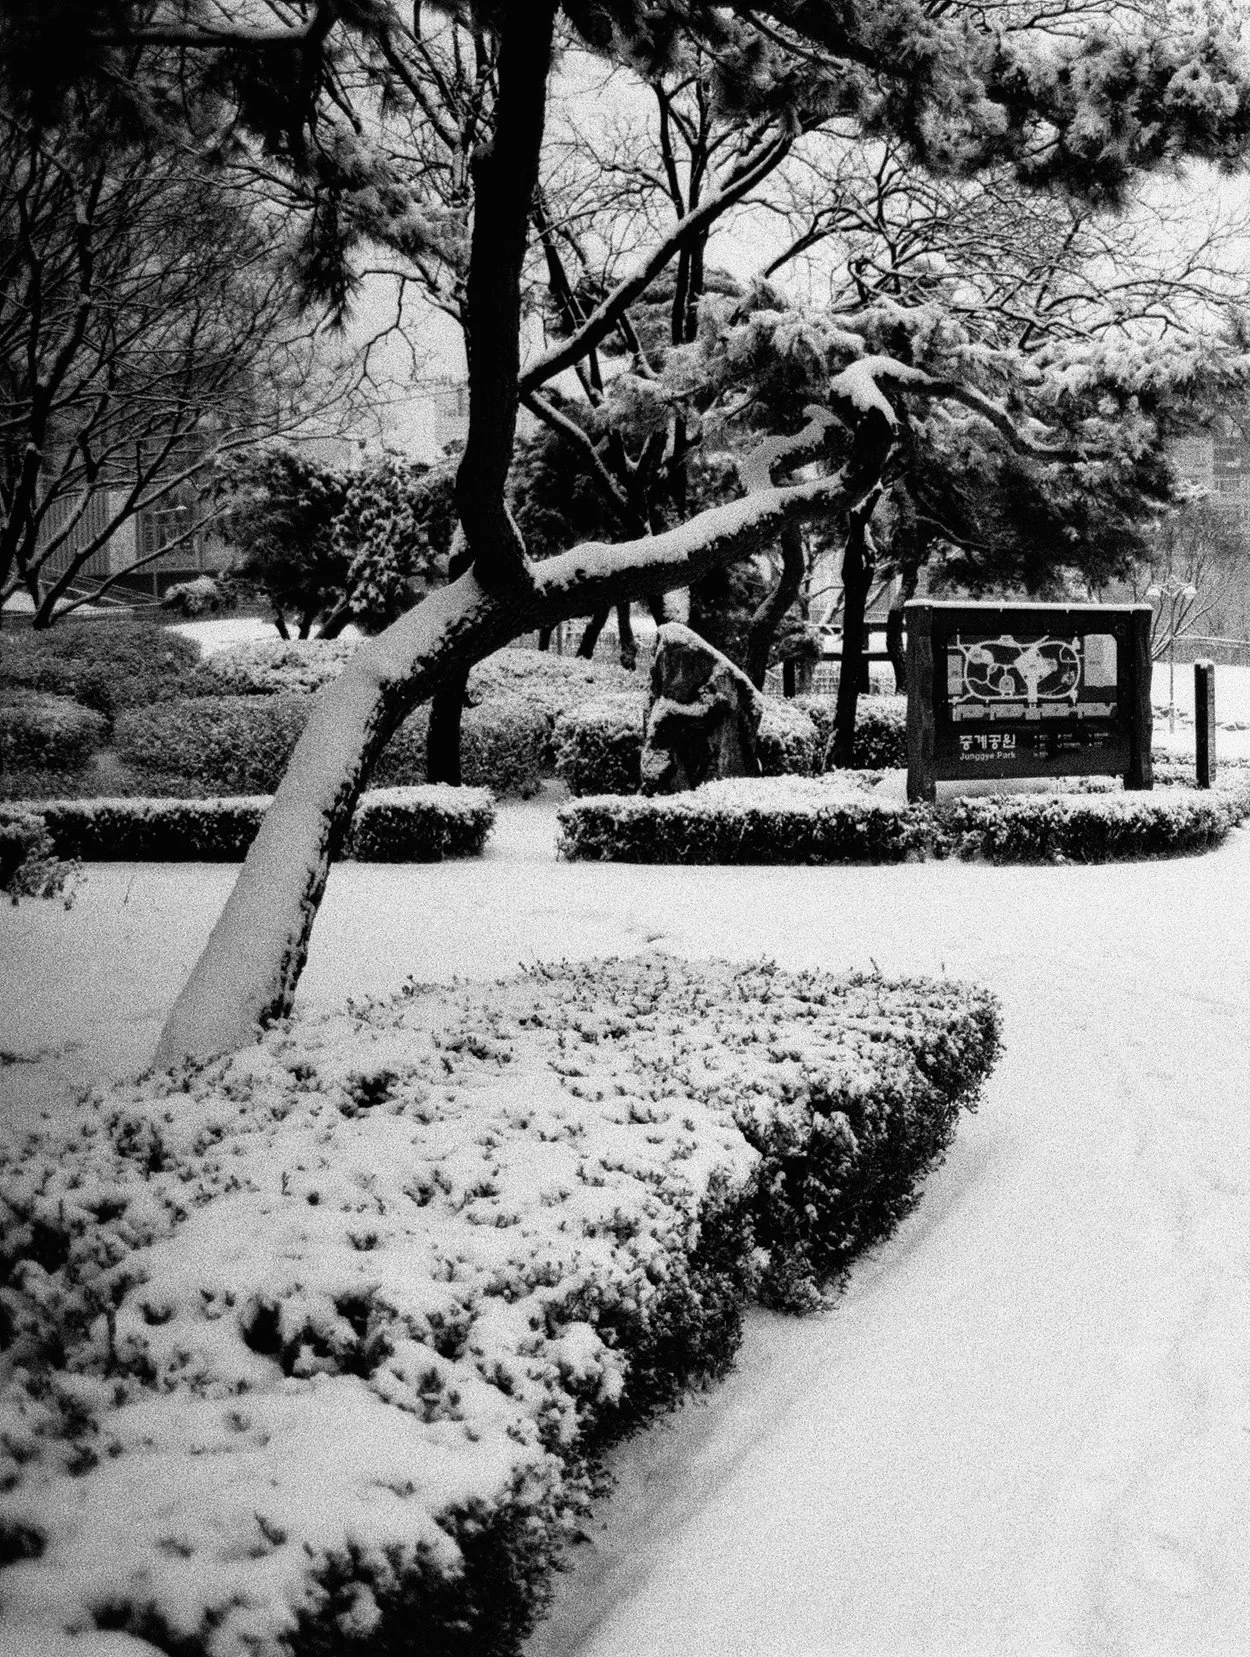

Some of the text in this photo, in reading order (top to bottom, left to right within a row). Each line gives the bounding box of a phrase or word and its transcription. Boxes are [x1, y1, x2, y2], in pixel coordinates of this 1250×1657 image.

[959, 733, 1016, 751] 중계공원
[959, 751, 1016, 762] Junggye Park
